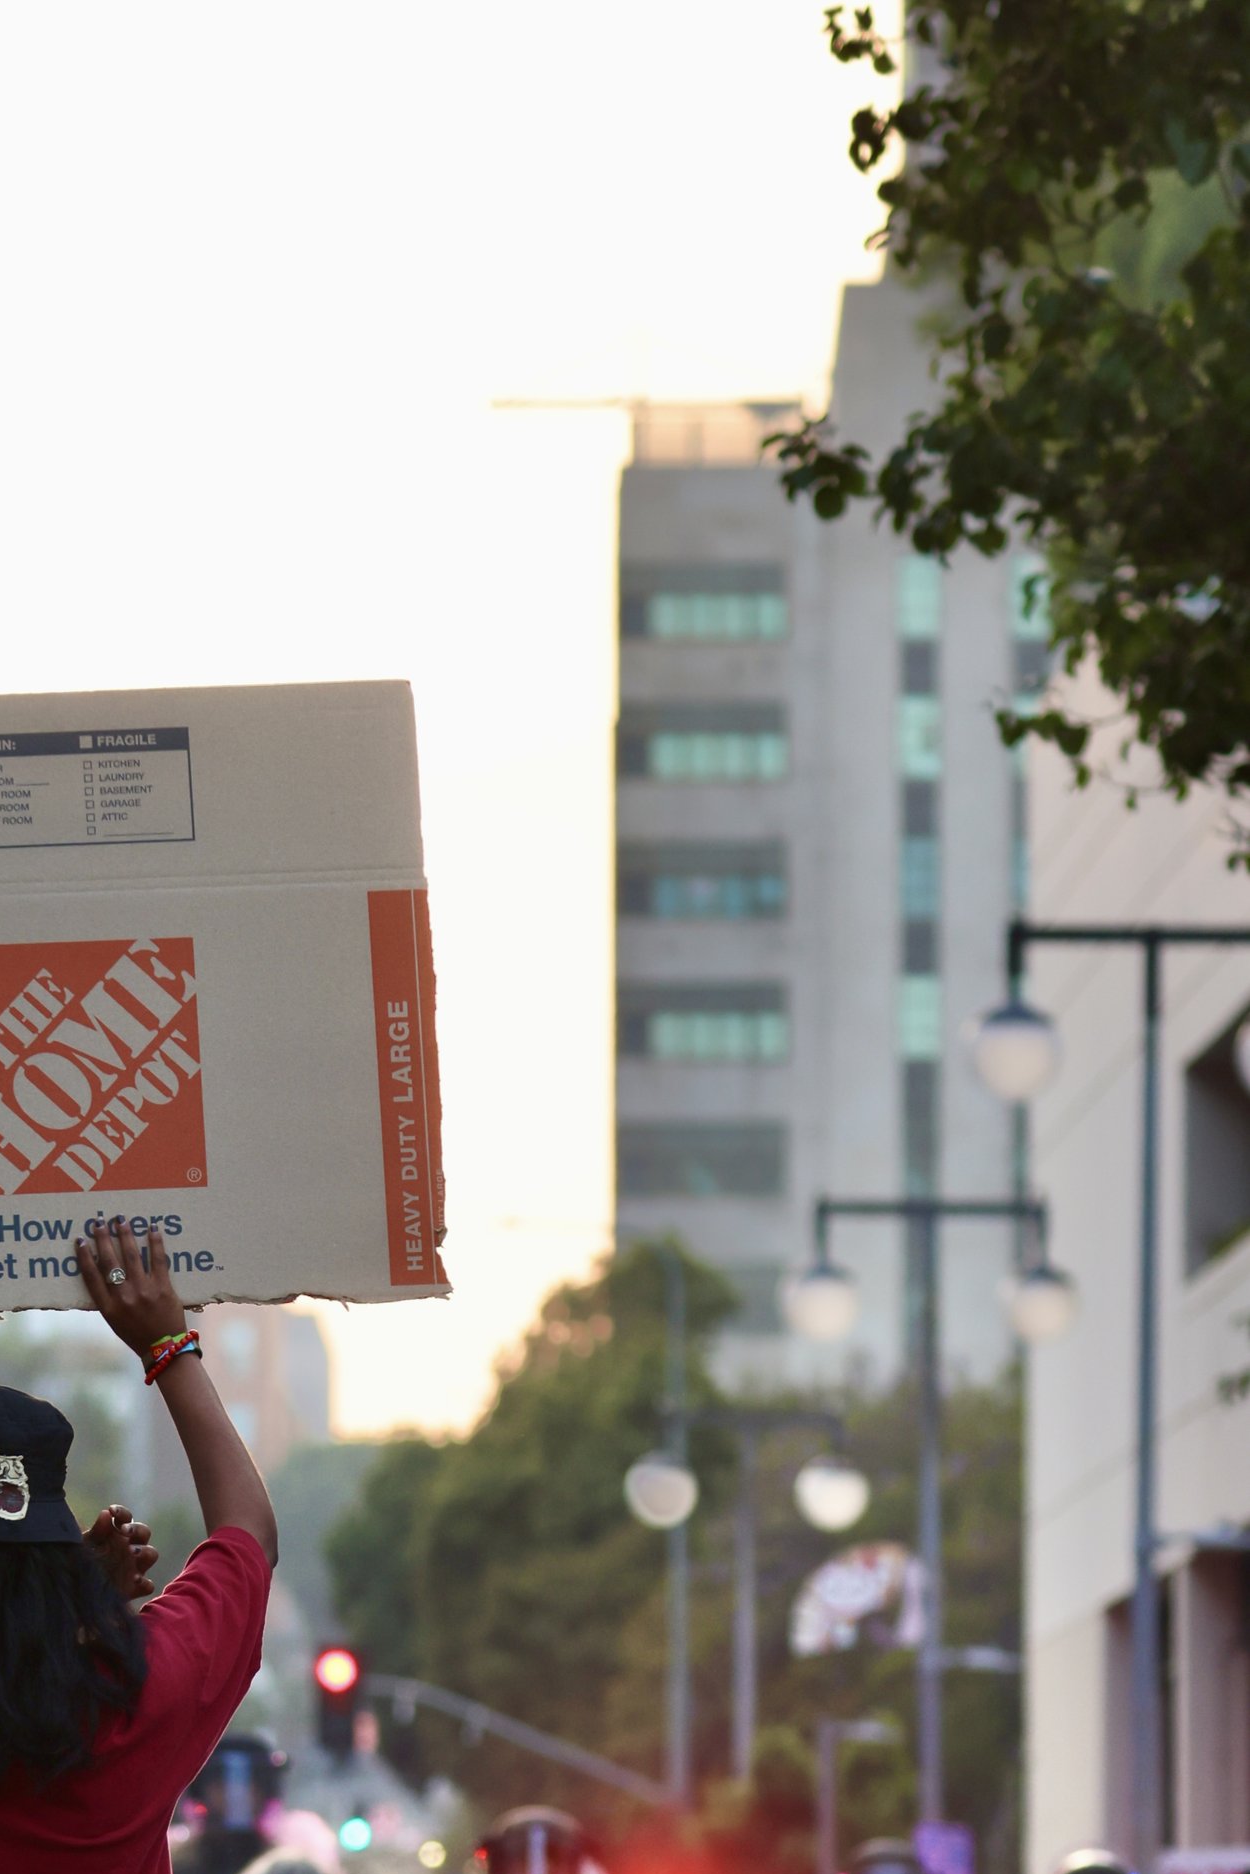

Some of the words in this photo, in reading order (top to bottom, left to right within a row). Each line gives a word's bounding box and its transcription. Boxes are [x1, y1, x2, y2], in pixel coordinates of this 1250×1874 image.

[97, 734, 157, 747] FRAGILE
[98, 759, 141, 769] KITCHEN
[99, 772, 145, 782] LAUNDRY
[1, 790, 31, 799] ROOM
[100, 784, 153, 795] BASEMENT
[0, 803, 30, 812] ROOM
[100, 798, 141, 808] GARAGE
[3, 816, 33, 826] ROOM
[101, 812, 129, 822] ATTIC
[387, 1000, 414, 1102] LARGE
[52, 1029, 201, 1192] DEPOT
[398, 1115, 419, 1181] DUTY
[402, 1192, 424, 1271] HEAVY
